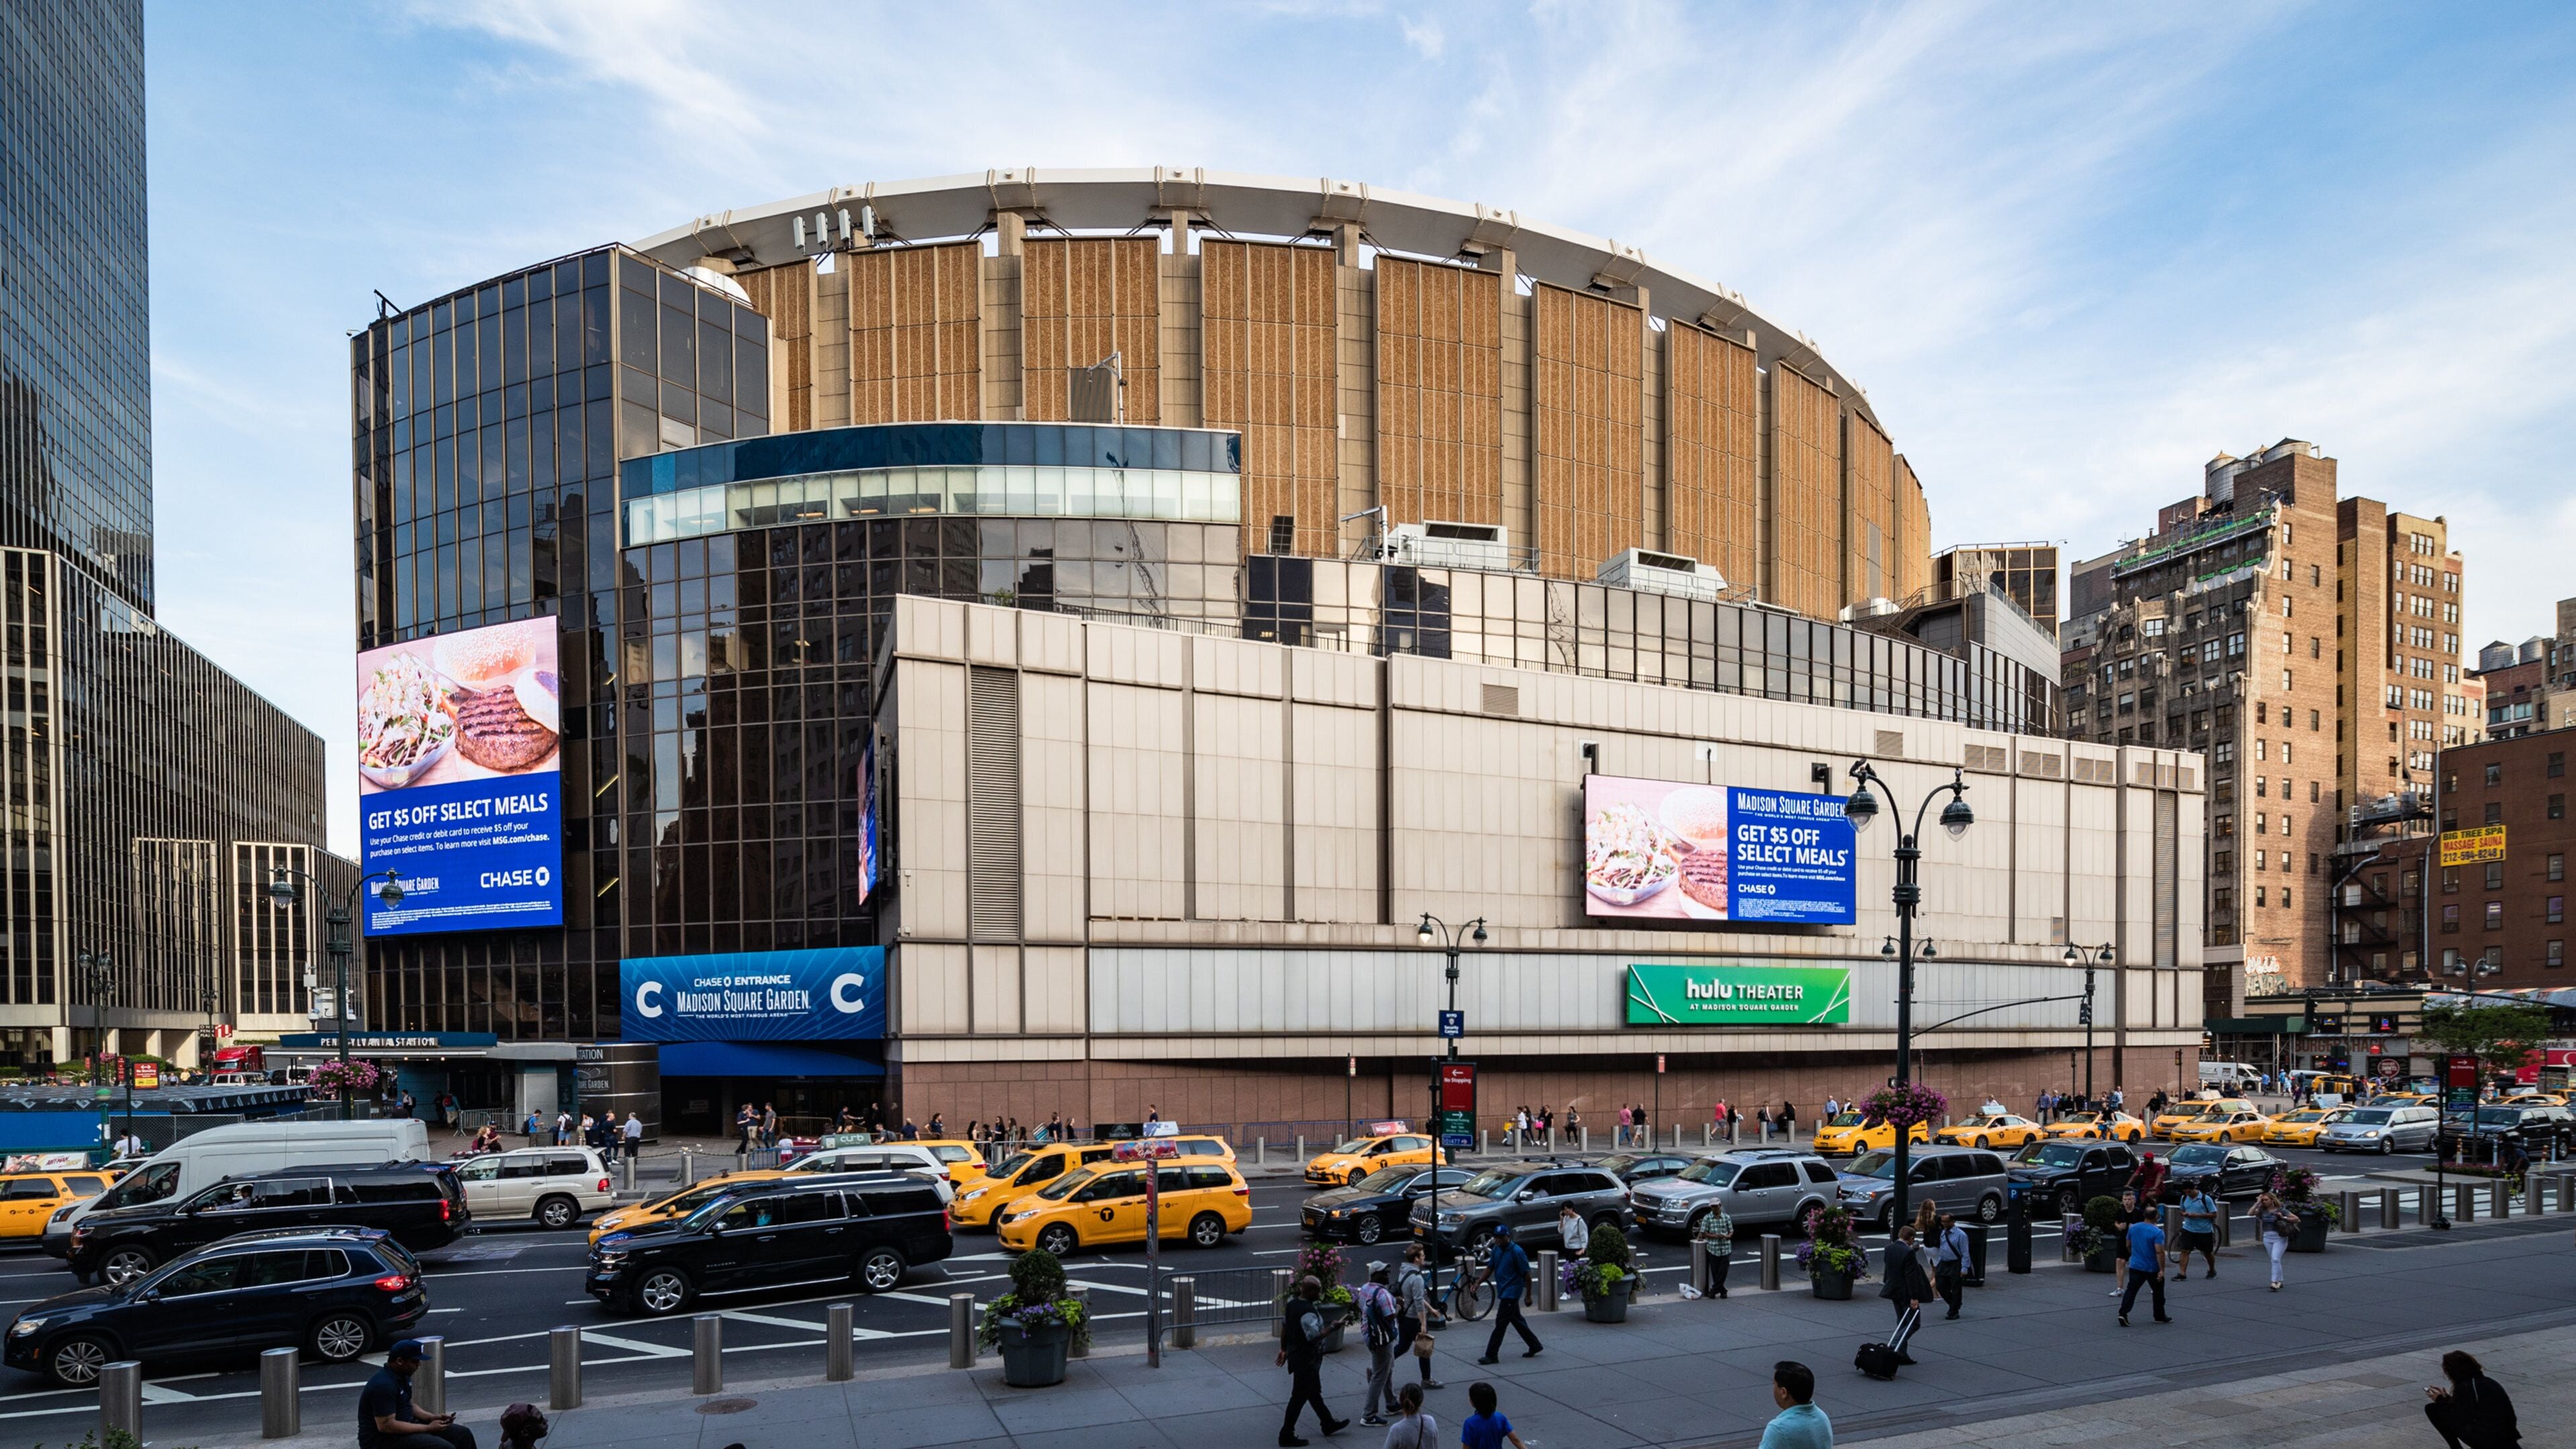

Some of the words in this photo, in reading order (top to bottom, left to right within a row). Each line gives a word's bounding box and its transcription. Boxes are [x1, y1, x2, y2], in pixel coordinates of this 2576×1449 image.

[369, 811, 392, 830] GET
[394, 808, 409, 828] $5
[411, 805, 437, 824] OFF
[440, 799, 491, 821] SELECT
[495, 793, 548, 816] MEALS
[1737, 792, 1776, 812] MADISON
[1779, 796, 1811, 815] SQUARE
[380, 837, 392, 846] your
[392, 834, 409, 843] Chase
[409, 833, 425, 841] credit
[433, 829, 448, 838] debit
[449, 828, 462, 837] card
[471, 825, 493, 834] receive
[494, 823, 502, 833] $5
[503, 822, 513, 831] off
[513, 822, 529, 833] your
[1737, 824, 1767, 843] GET
[1770, 826, 1788, 845] $5
[1791, 828, 1820, 846] OFF
[2443, 832, 2458, 841] BIG
[2461, 829, 2483, 839] TREE
[2485, 827, 2503, 836] SPA
[2443, 839, 2475, 851] MASSAGE
[2479, 837, 2503, 847] SAUNA
[370, 847, 393, 859] purchase
[402, 844, 417, 853] select
[436, 842, 443, 850] To
[444, 840, 460, 849] learn
[461, 839, 478, 847] more
[478, 837, 491, 846] visit
[1737, 843, 1792, 863] SELECT
[480, 869, 533, 888] CHASE
[1738, 884, 1767, 894] CHASE
[694, 978, 722, 987] CHASE
[735, 975, 792, 985] ENTRANCE
[1687, 979, 1732, 998] hulu
[1737, 985, 1803, 999] THEATER
[636, 981, 663, 1018] C
[677, 991, 721, 1012] MADISON
[724, 989, 763, 1012] SQUARE
[830, 973, 865, 1014] C
[395, 1037, 435, 1046] STATION
[2011, 1189, 2017, 1198] P
[1103, 1210, 1111, 1220] T
